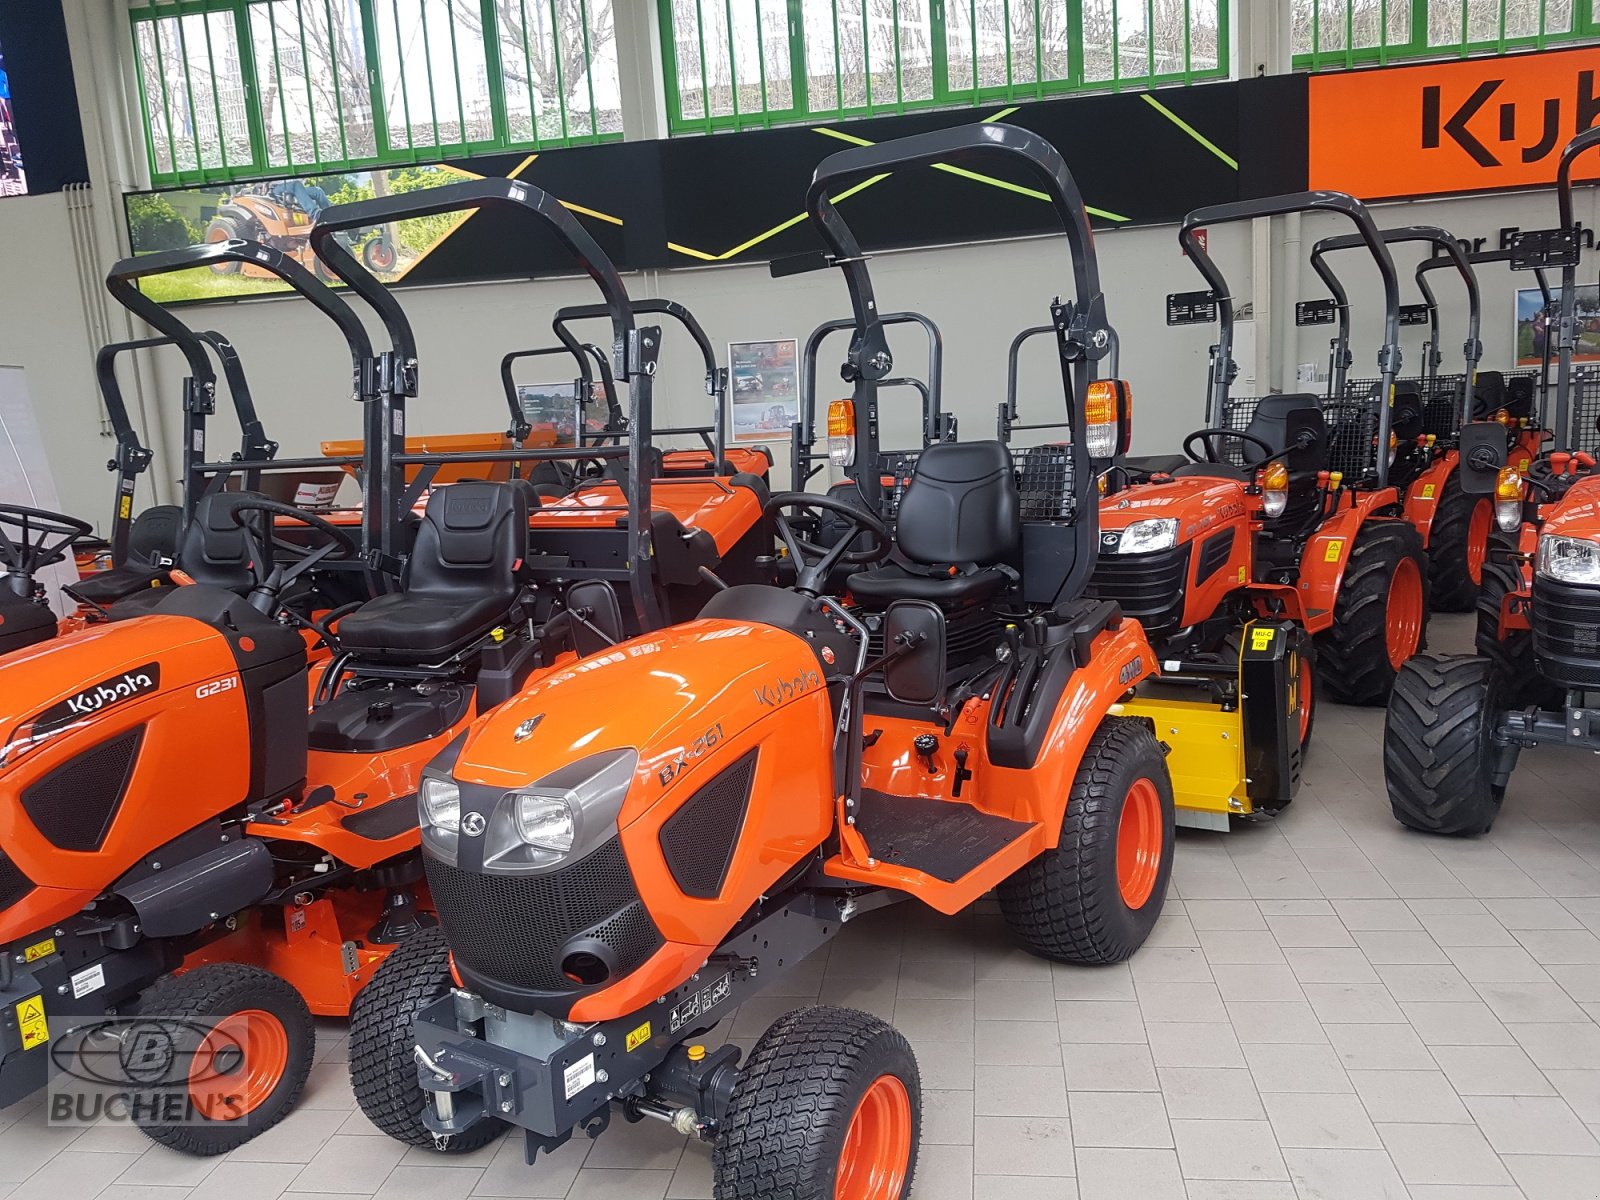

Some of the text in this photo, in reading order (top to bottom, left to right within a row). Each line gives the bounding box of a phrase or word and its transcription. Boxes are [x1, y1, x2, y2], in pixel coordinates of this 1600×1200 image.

[1119, 655, 1142, 685] 4WD
[66, 673, 153, 713] Kubota
[195, 676, 238, 699] G231
[753, 669, 821, 707] Kubota
